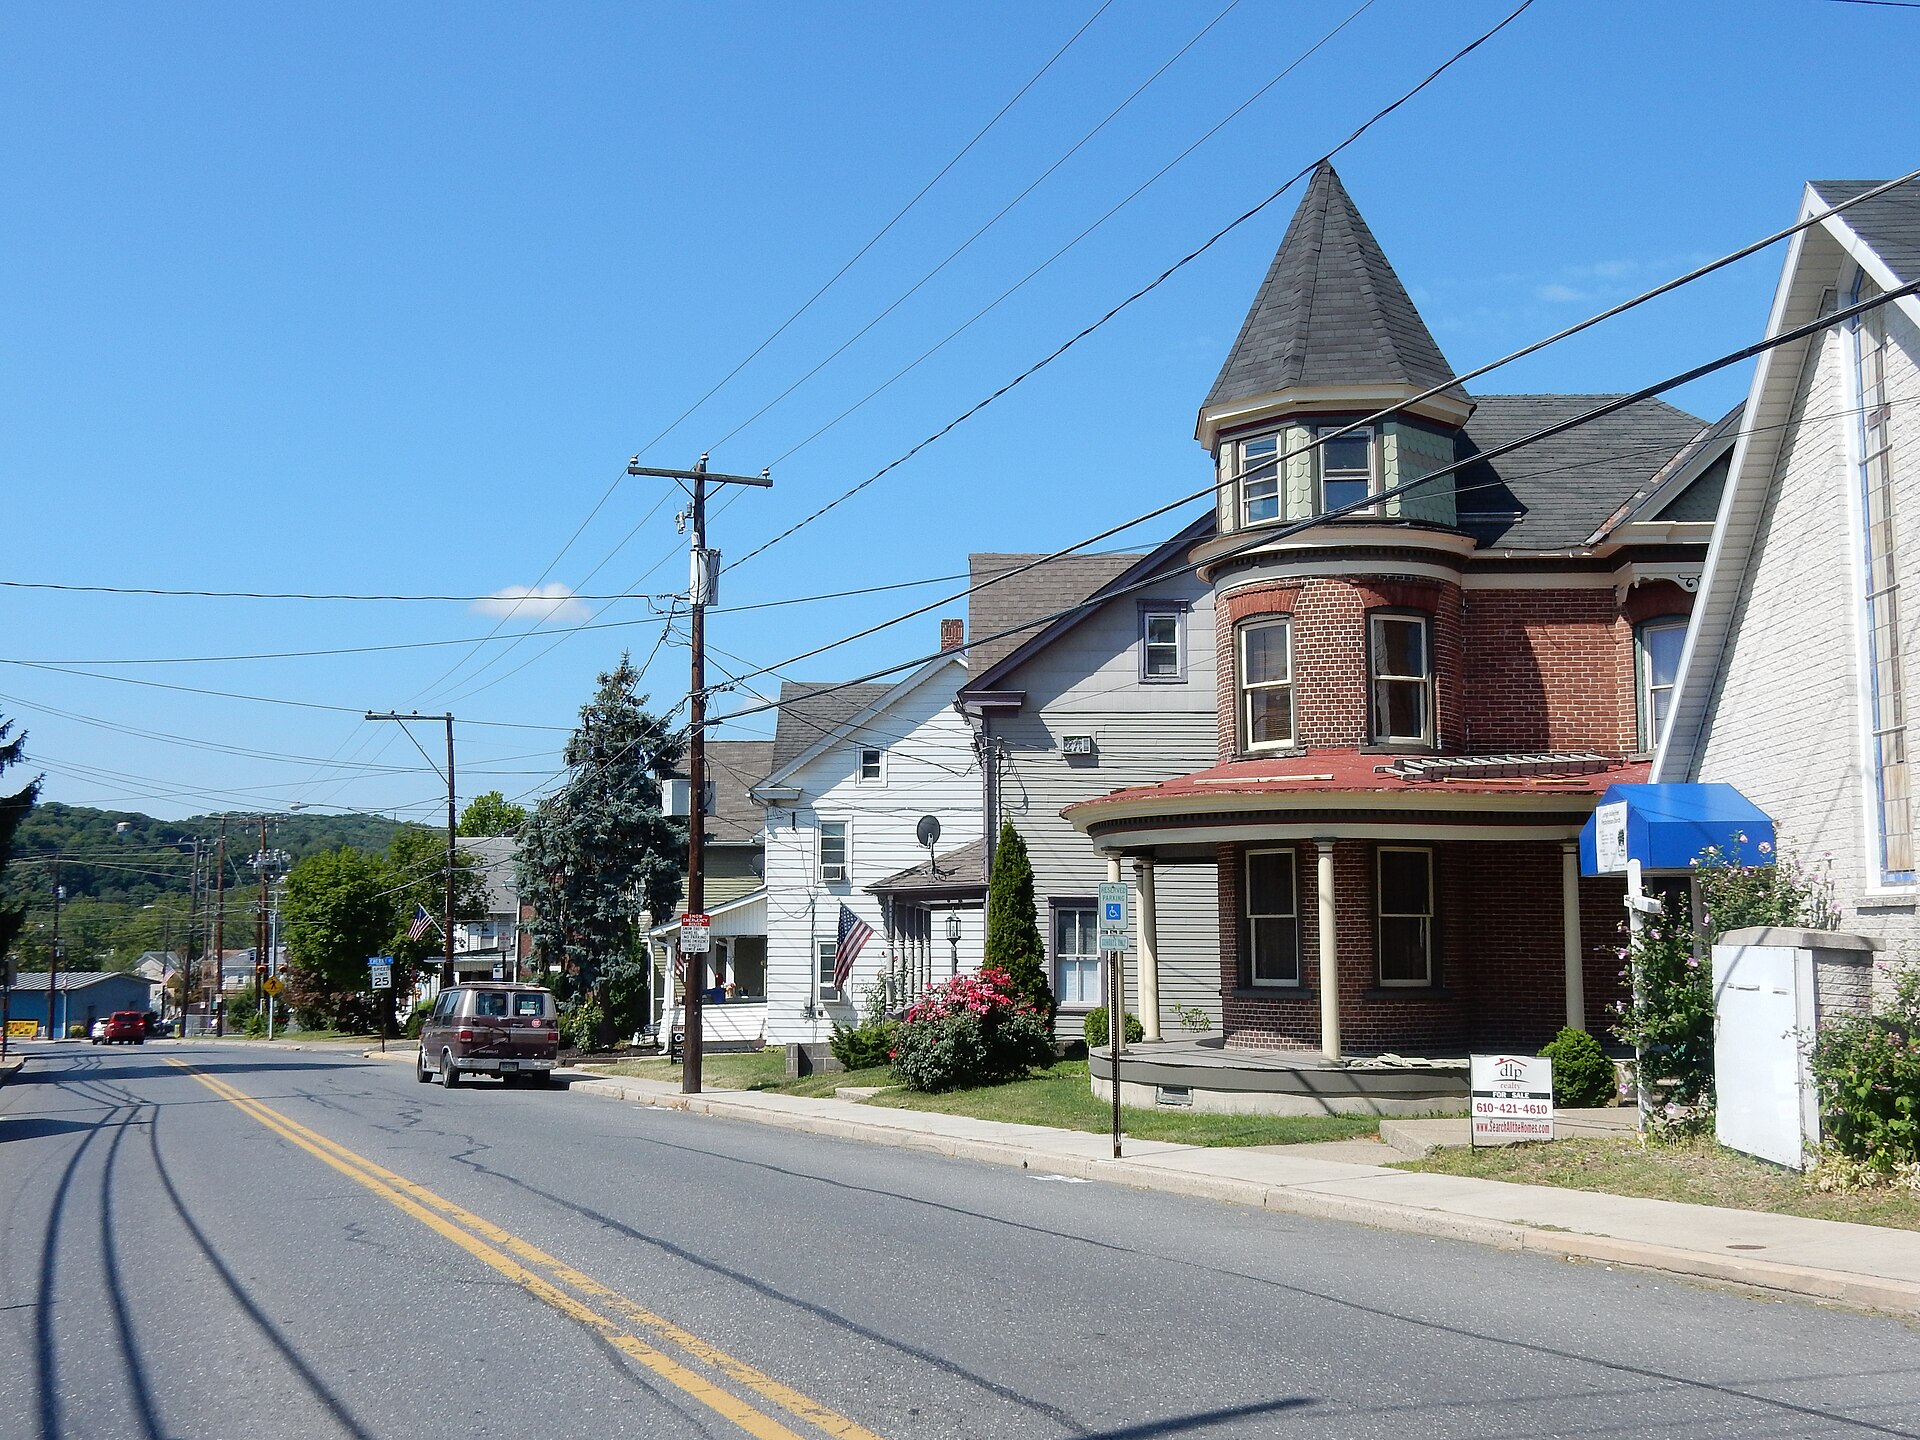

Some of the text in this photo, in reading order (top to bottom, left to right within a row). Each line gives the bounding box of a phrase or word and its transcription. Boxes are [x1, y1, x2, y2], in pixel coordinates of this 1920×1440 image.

[374, 977, 390, 987] 25
[1499, 1063, 1523, 1081] dlp
[1500, 1082, 1521, 1090] realty
[1476, 1102, 1548, 1115] 610-421-4610
[1476, 1120, 1550, 1134] www.SearchAlltheHomes.com
